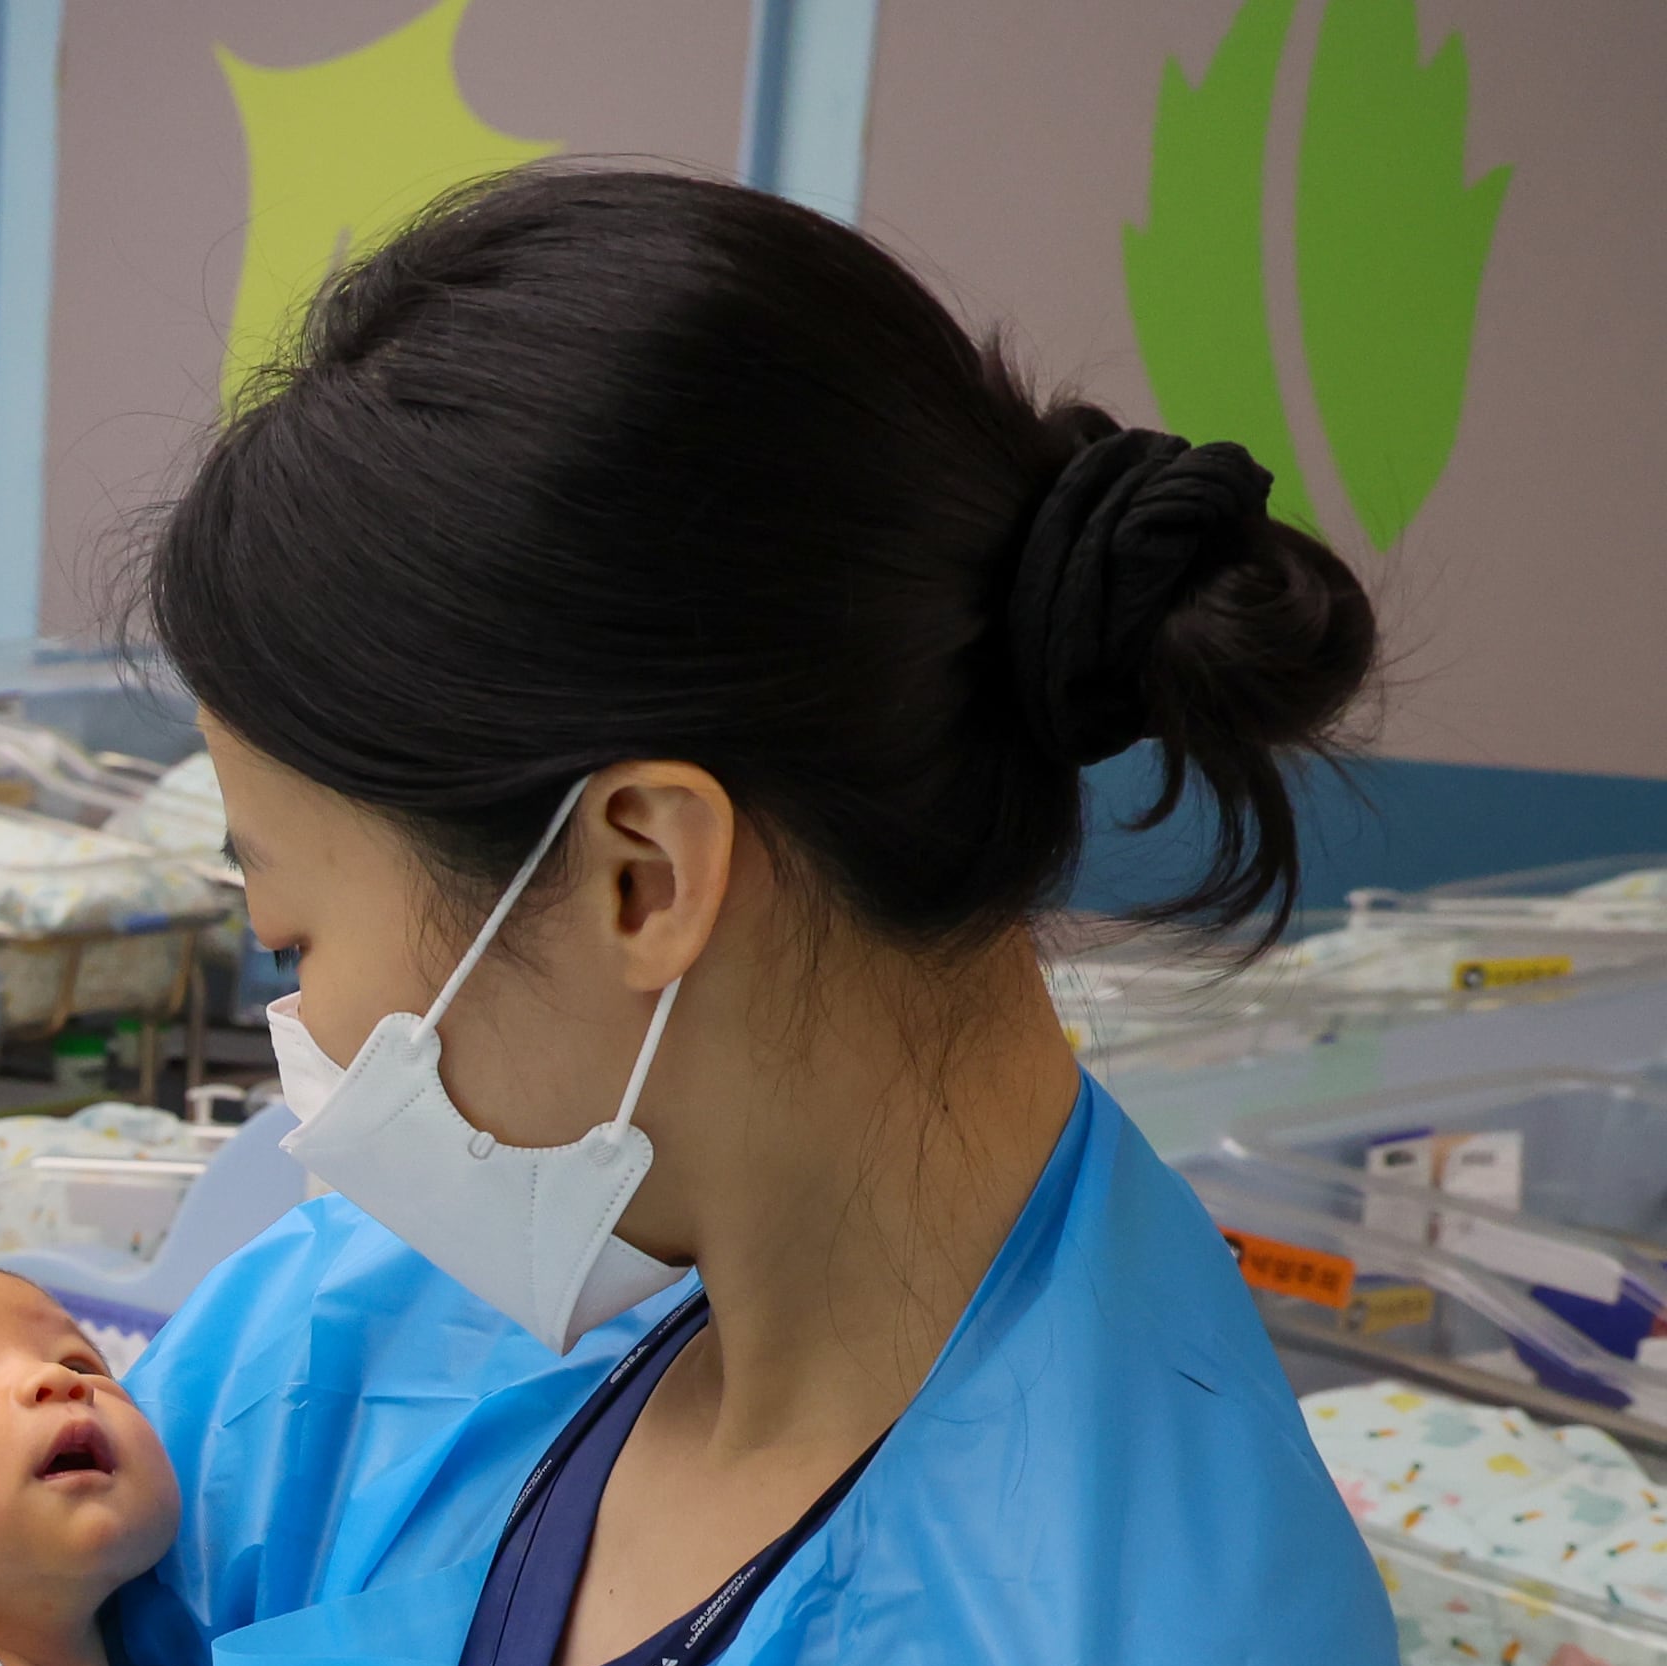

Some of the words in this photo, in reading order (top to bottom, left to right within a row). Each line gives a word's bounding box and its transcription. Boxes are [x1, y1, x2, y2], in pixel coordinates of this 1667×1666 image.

[703, 1596, 731, 1628] MEDICAL
[730, 1566, 757, 1596] CENTER
[704, 1573, 743, 1616] UNIVERSITY
